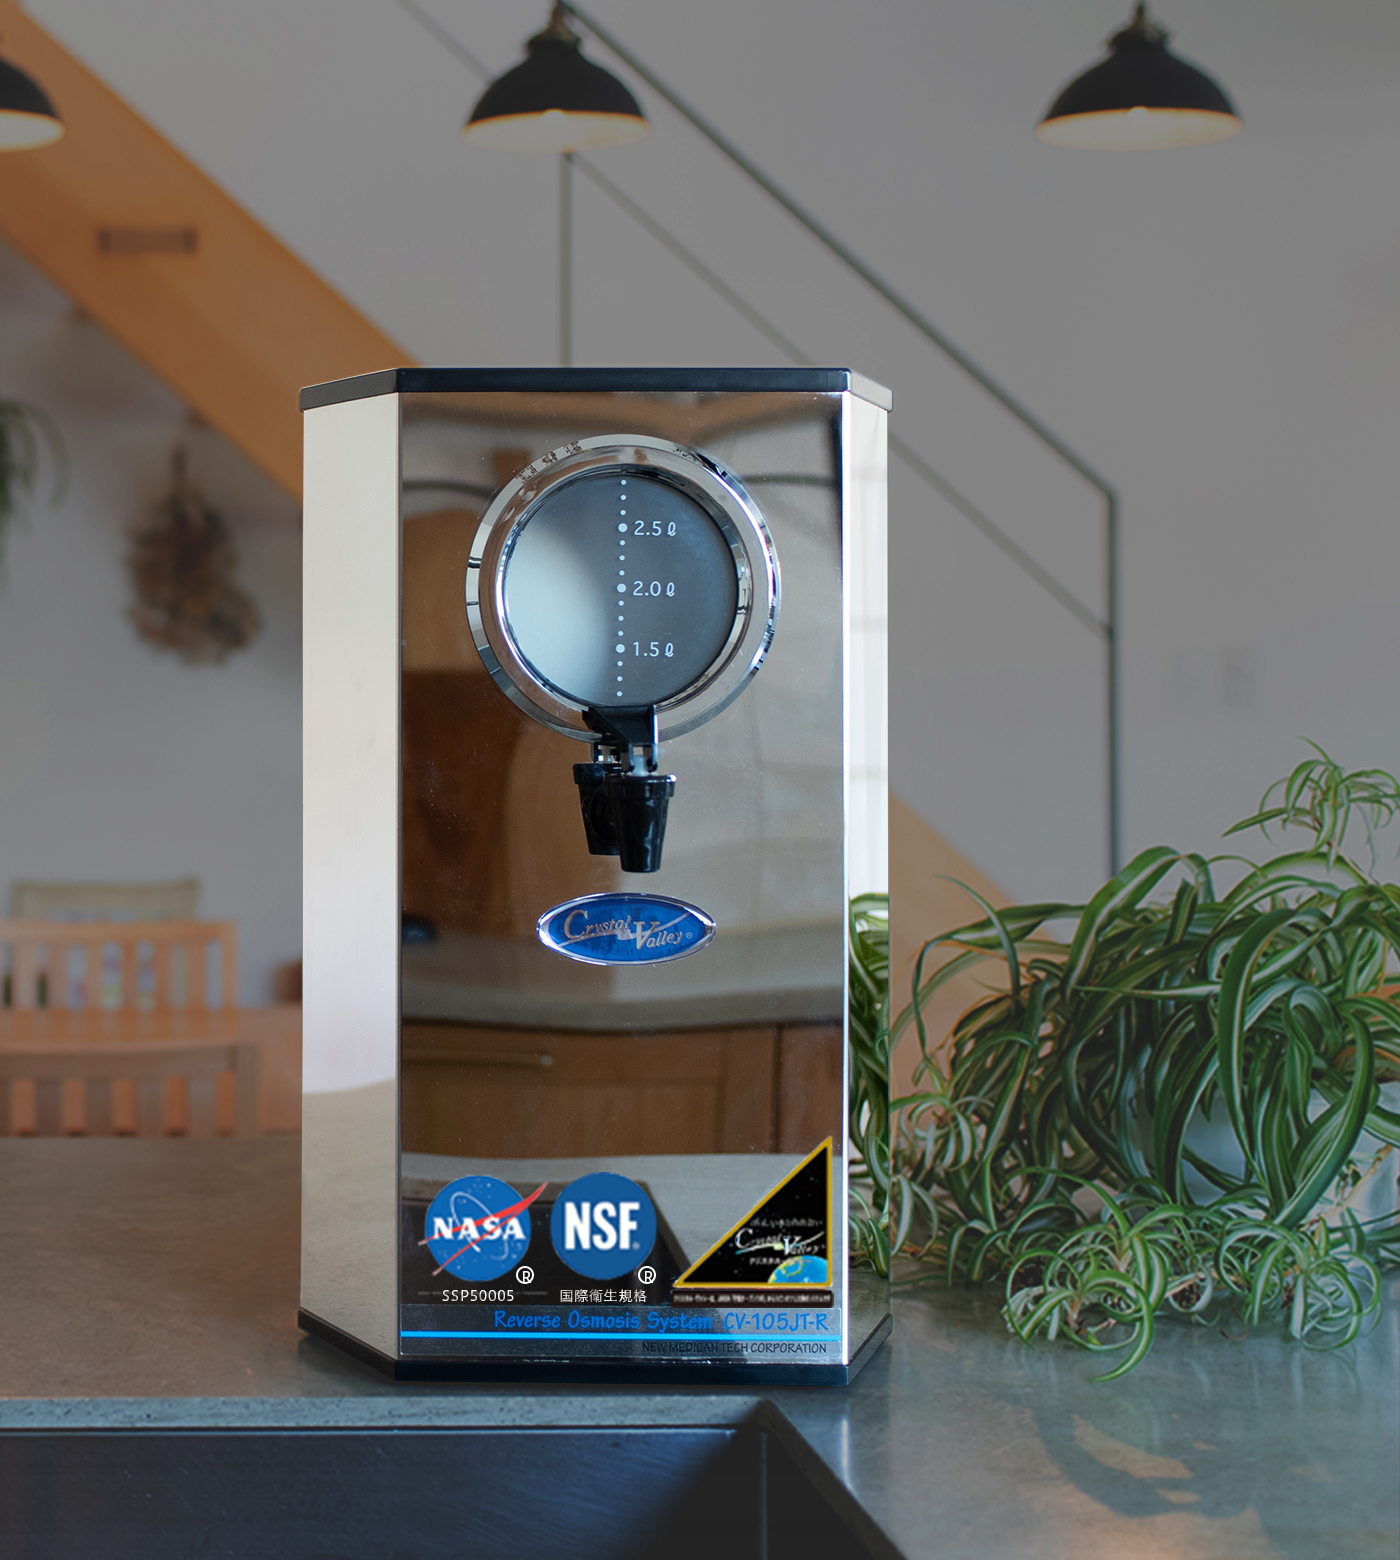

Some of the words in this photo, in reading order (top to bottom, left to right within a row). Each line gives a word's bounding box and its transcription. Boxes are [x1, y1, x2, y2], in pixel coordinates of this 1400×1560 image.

[634, 520, 662, 537] 2.5
[632, 580, 662, 597] 2.0
[633, 641, 660, 657] 1.5
[563, 909, 632, 940] Crystal
[633, 921, 683, 950] Valley
[432, 1217, 526, 1241] NASA
[564, 1201, 641, 1250] NSF
[441, 1289, 515, 1303] SSP50005
[559, 1289, 648, 1304] 国際衛生規格
[494, 1310, 561, 1329] Reverse
[567, 1310, 641, 1329] Osmosis
[647, 1311, 713, 1334] System
[723, 1312, 829, 1331] CV-105JT-R
[642, 1342, 667, 1353] NEW
[721, 1342, 748, 1354] TECH
[750, 1342, 827, 1354] CORPORATION
